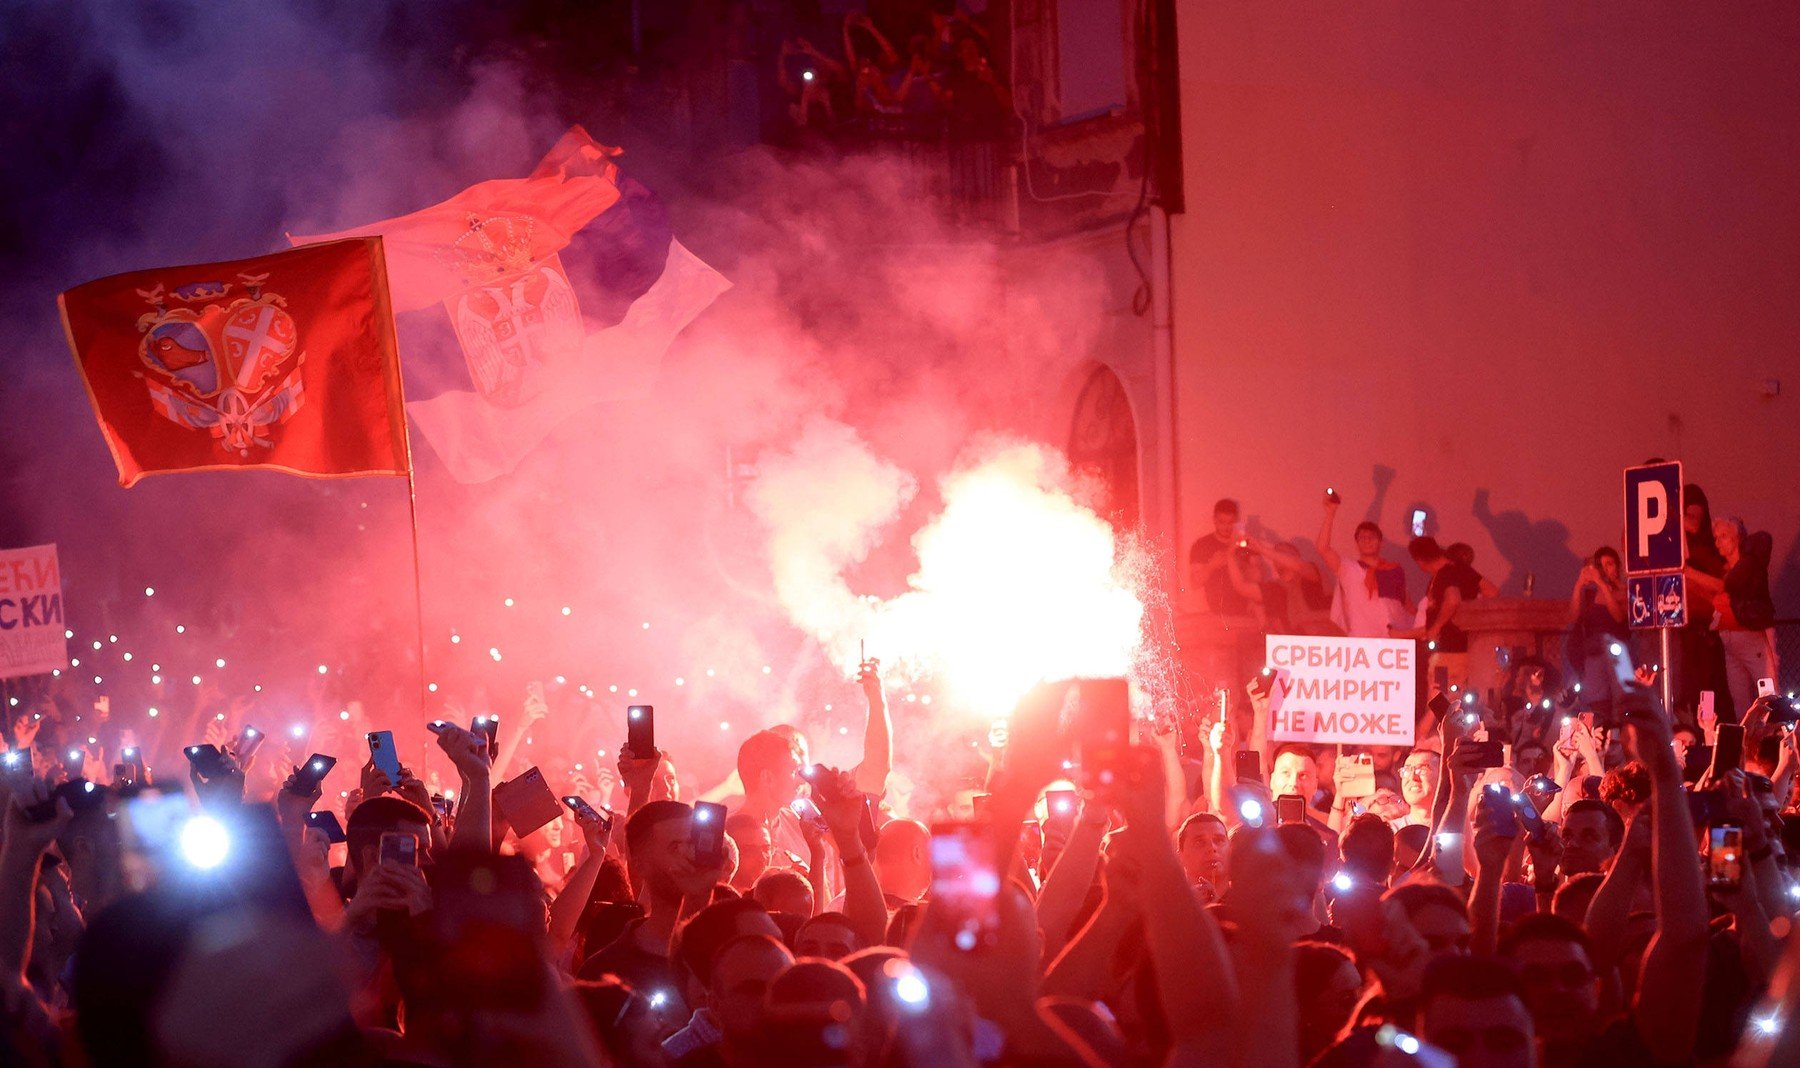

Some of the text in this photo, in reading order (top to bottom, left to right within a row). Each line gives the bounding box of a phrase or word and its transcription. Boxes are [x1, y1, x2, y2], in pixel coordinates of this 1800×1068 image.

[1638, 480, 1668, 557] P
[1271, 645, 1409, 672] СРБИЈА СЕ
[1279, 678, 1400, 702] УМИРИТ'
[1272, 710, 1408, 735] НЕ МОЖЕ.
